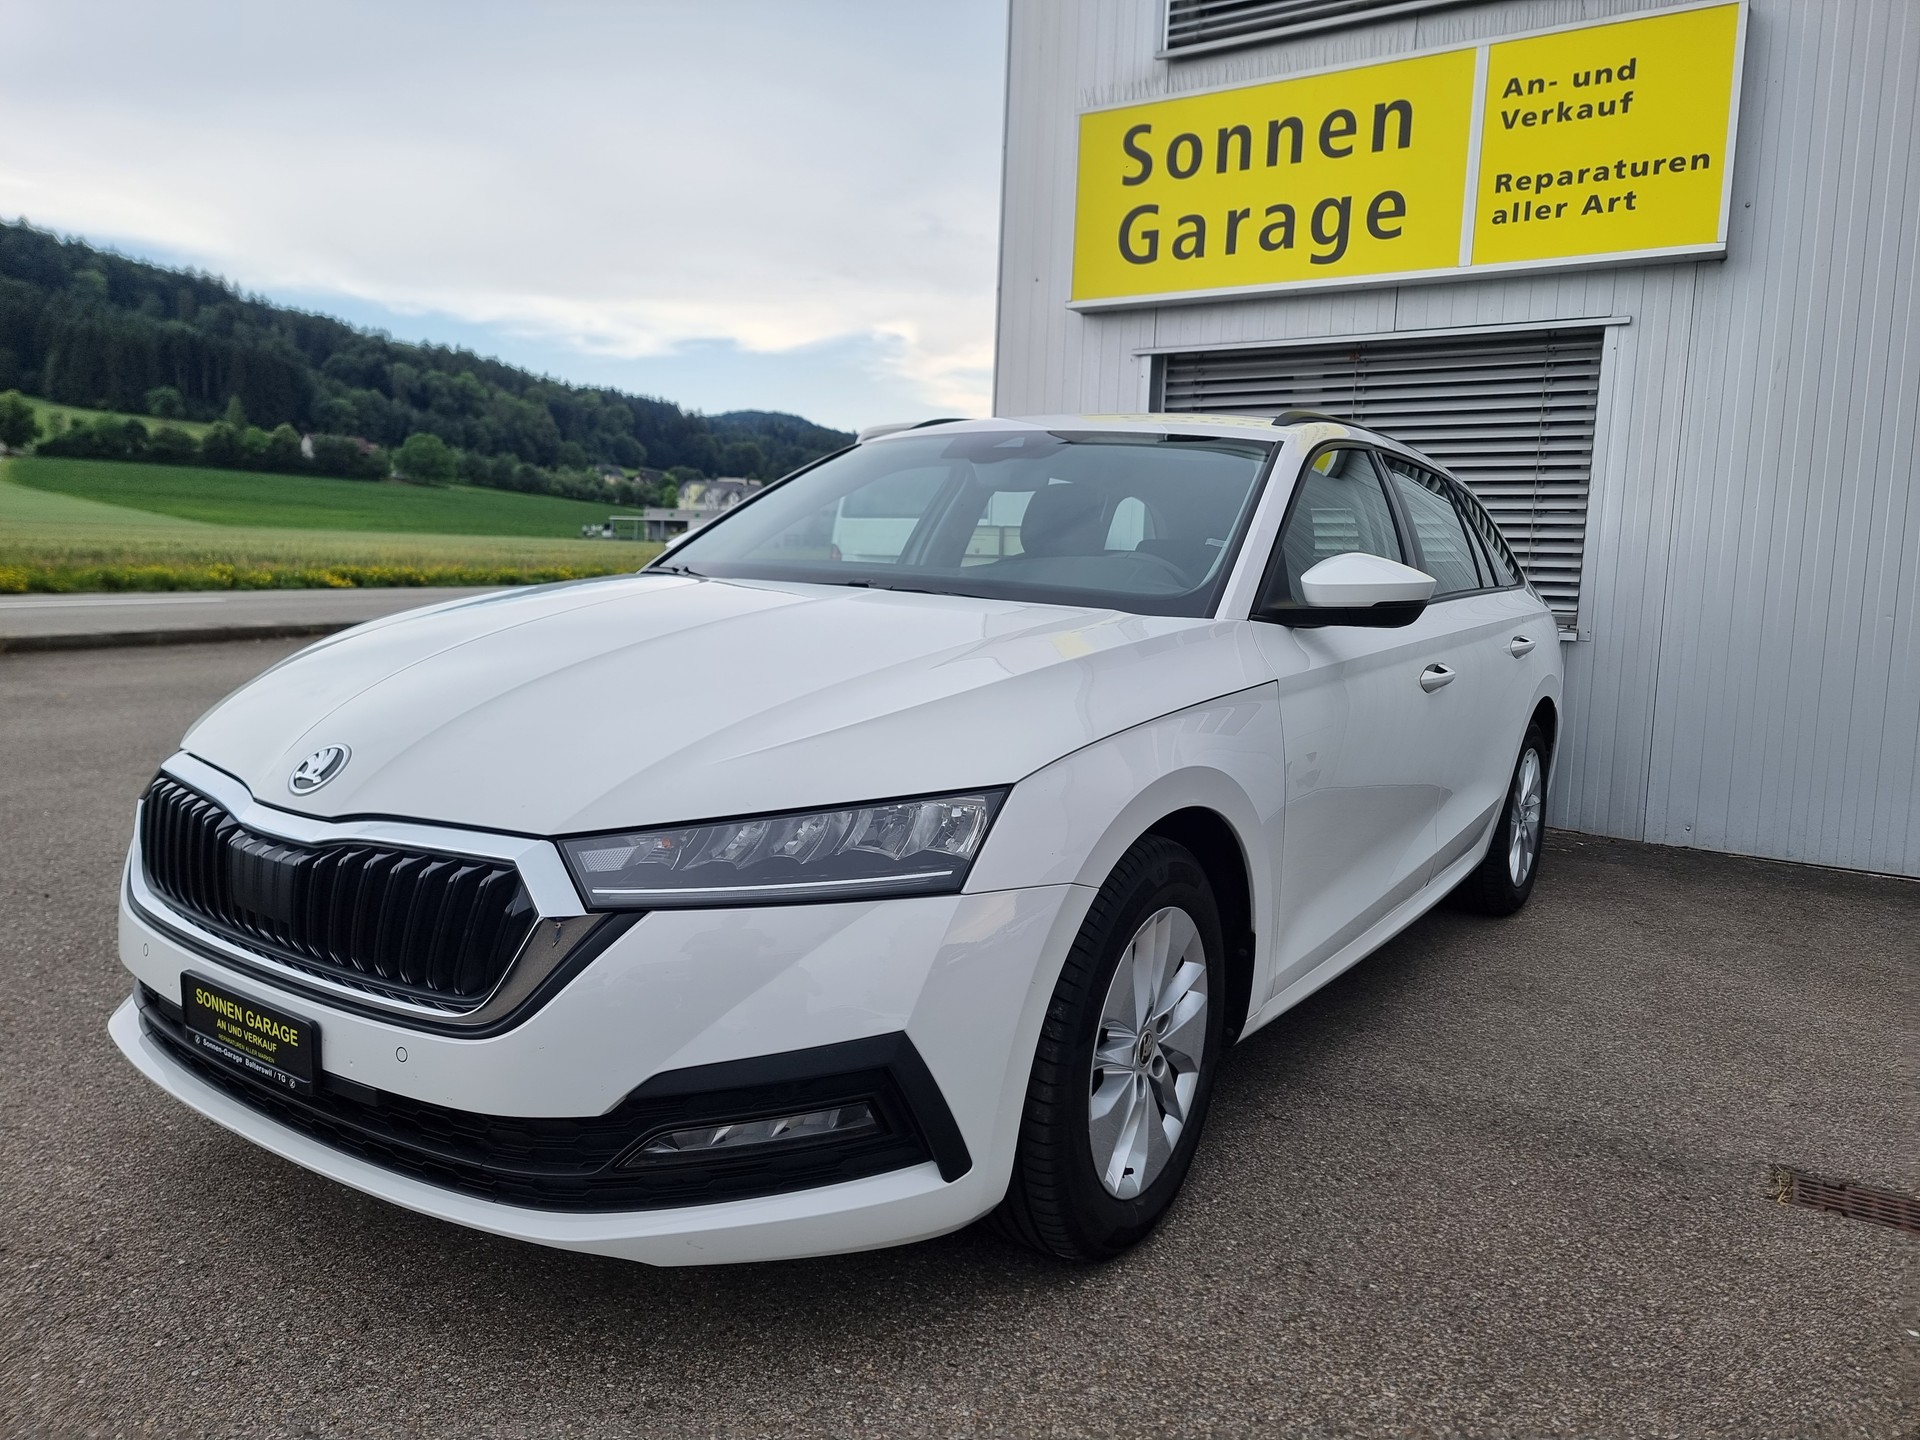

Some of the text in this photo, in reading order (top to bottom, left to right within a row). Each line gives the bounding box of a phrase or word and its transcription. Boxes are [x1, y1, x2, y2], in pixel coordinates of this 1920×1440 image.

[1502, 57, 1637, 99] An- und
[1500, 91, 1635, 130] Verkauf
[1121, 98, 1413, 187] Sonnen
[1495, 153, 1711, 195] Reparaturen
[1117, 190, 1406, 265] Garage
[1491, 190, 1637, 226] aller Art
[196, 988, 299, 1047] SONNEN GARAGE
[216, 1019, 277, 1053] AN UND VERKAUF
[202, 1038, 243, 1064] Sonnen-Garage
[277, 1072, 286, 1083] TG
